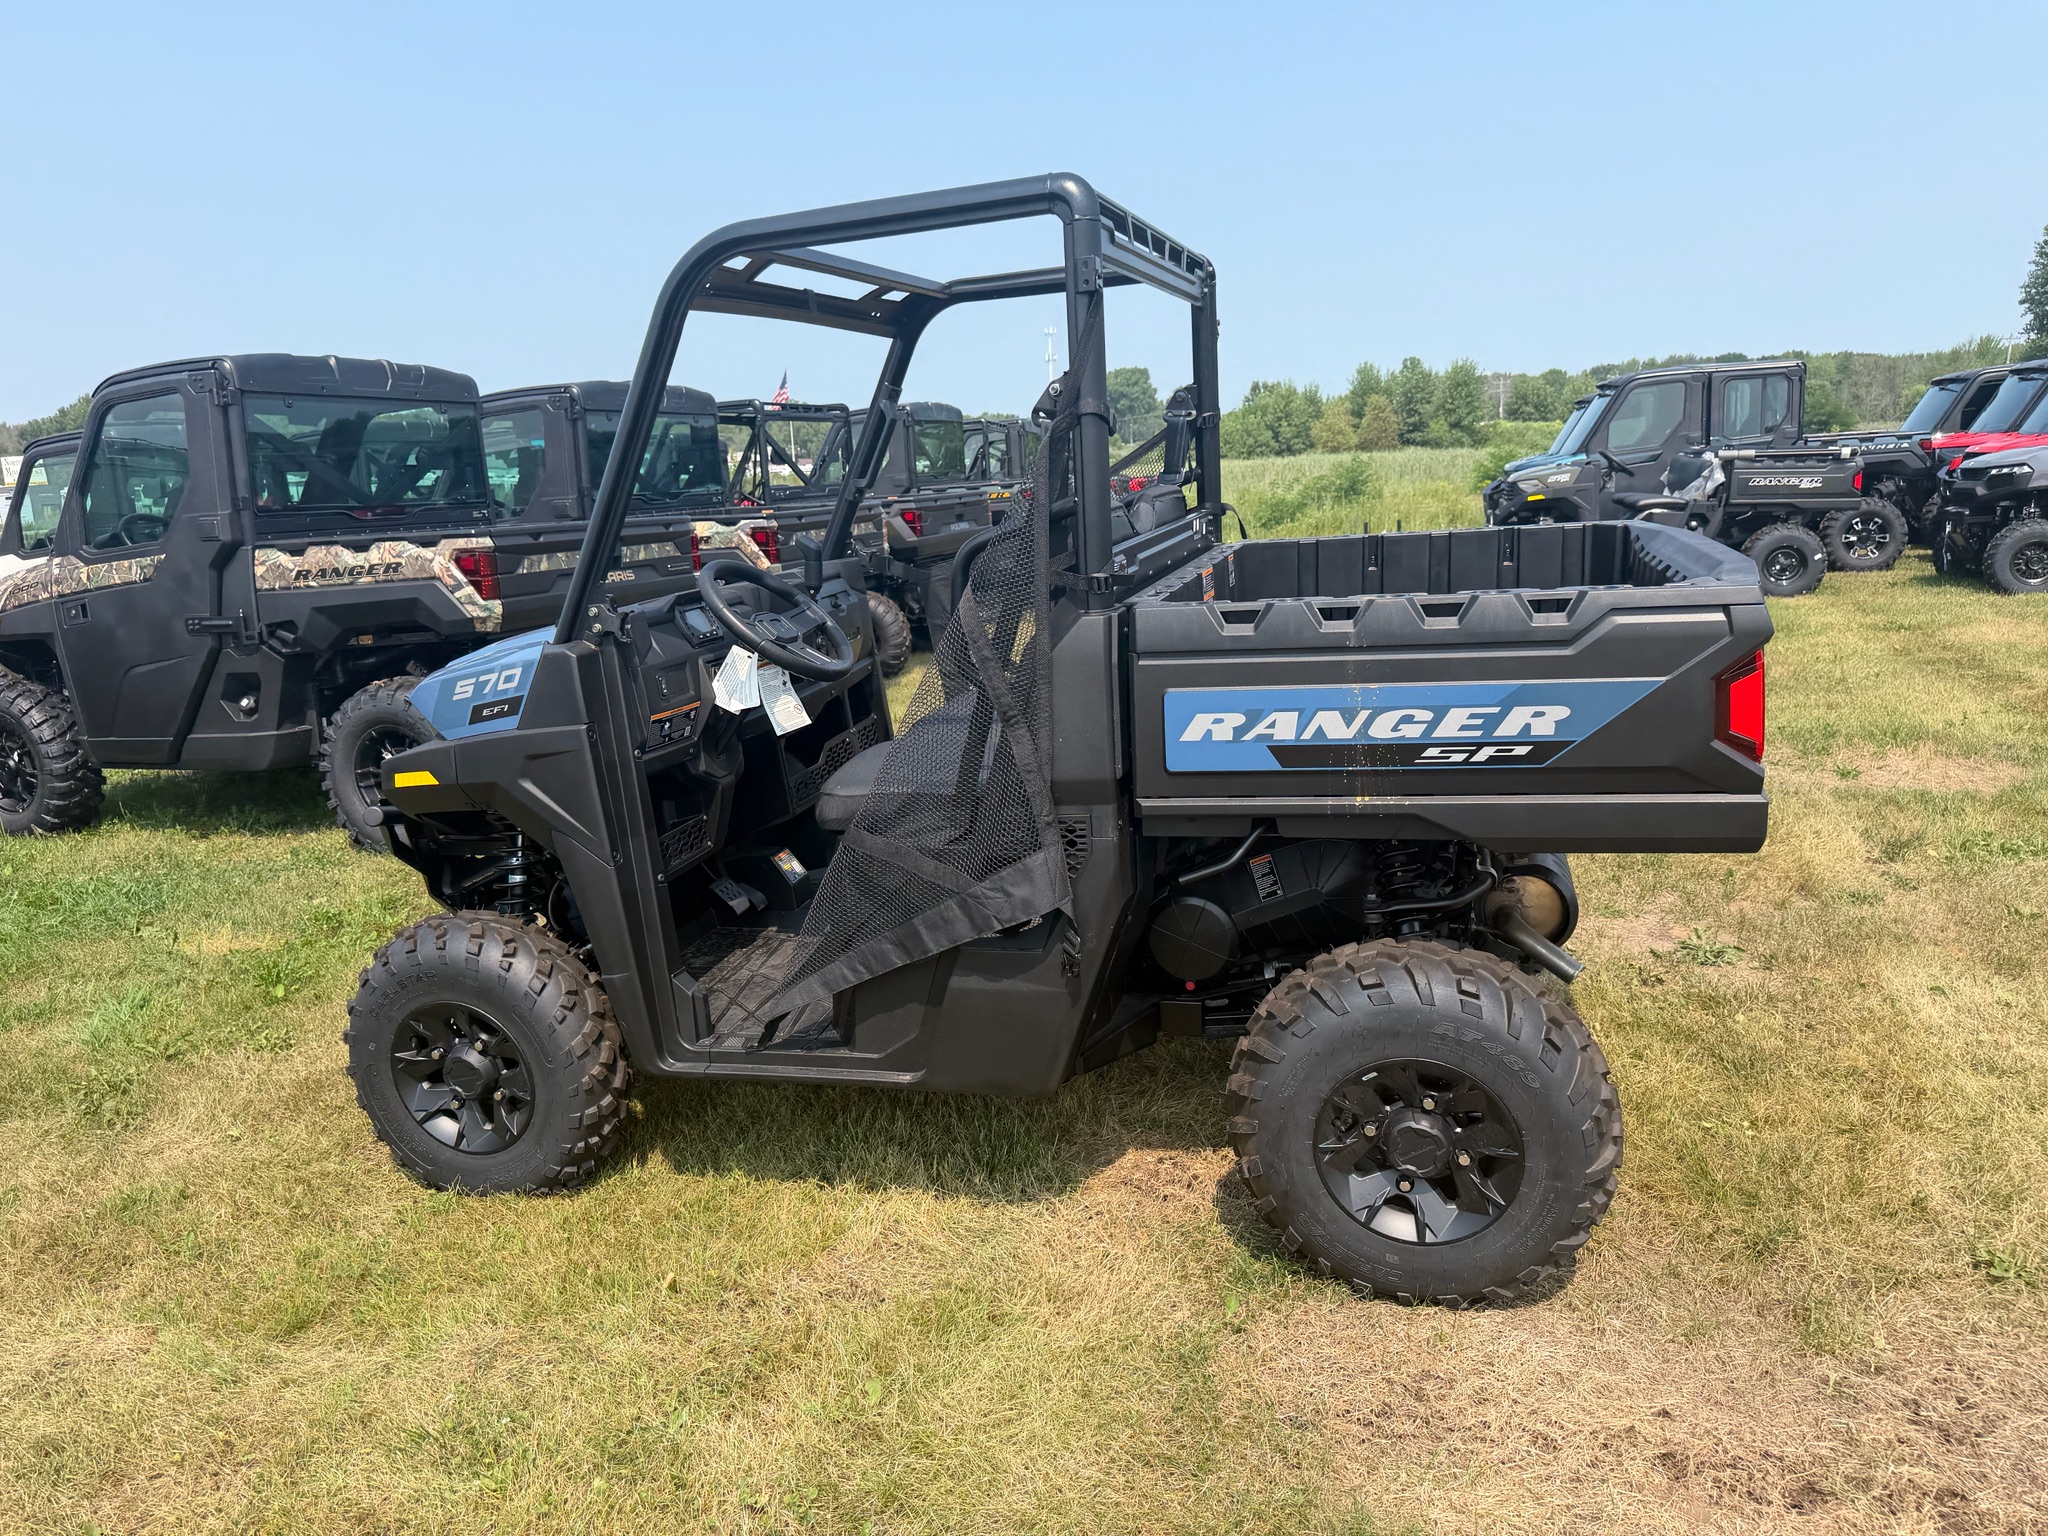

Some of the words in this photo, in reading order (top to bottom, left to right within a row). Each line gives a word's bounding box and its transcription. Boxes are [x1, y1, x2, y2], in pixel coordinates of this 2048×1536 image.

[1748, 477, 1822, 486] RANGER
[293, 562, 405, 582] RANGER
[452, 667, 522, 701] 570
[482, 704, 509, 717] EFI
[1179, 705, 1572, 742] RANGER
[1414, 746, 1534, 764] SP
